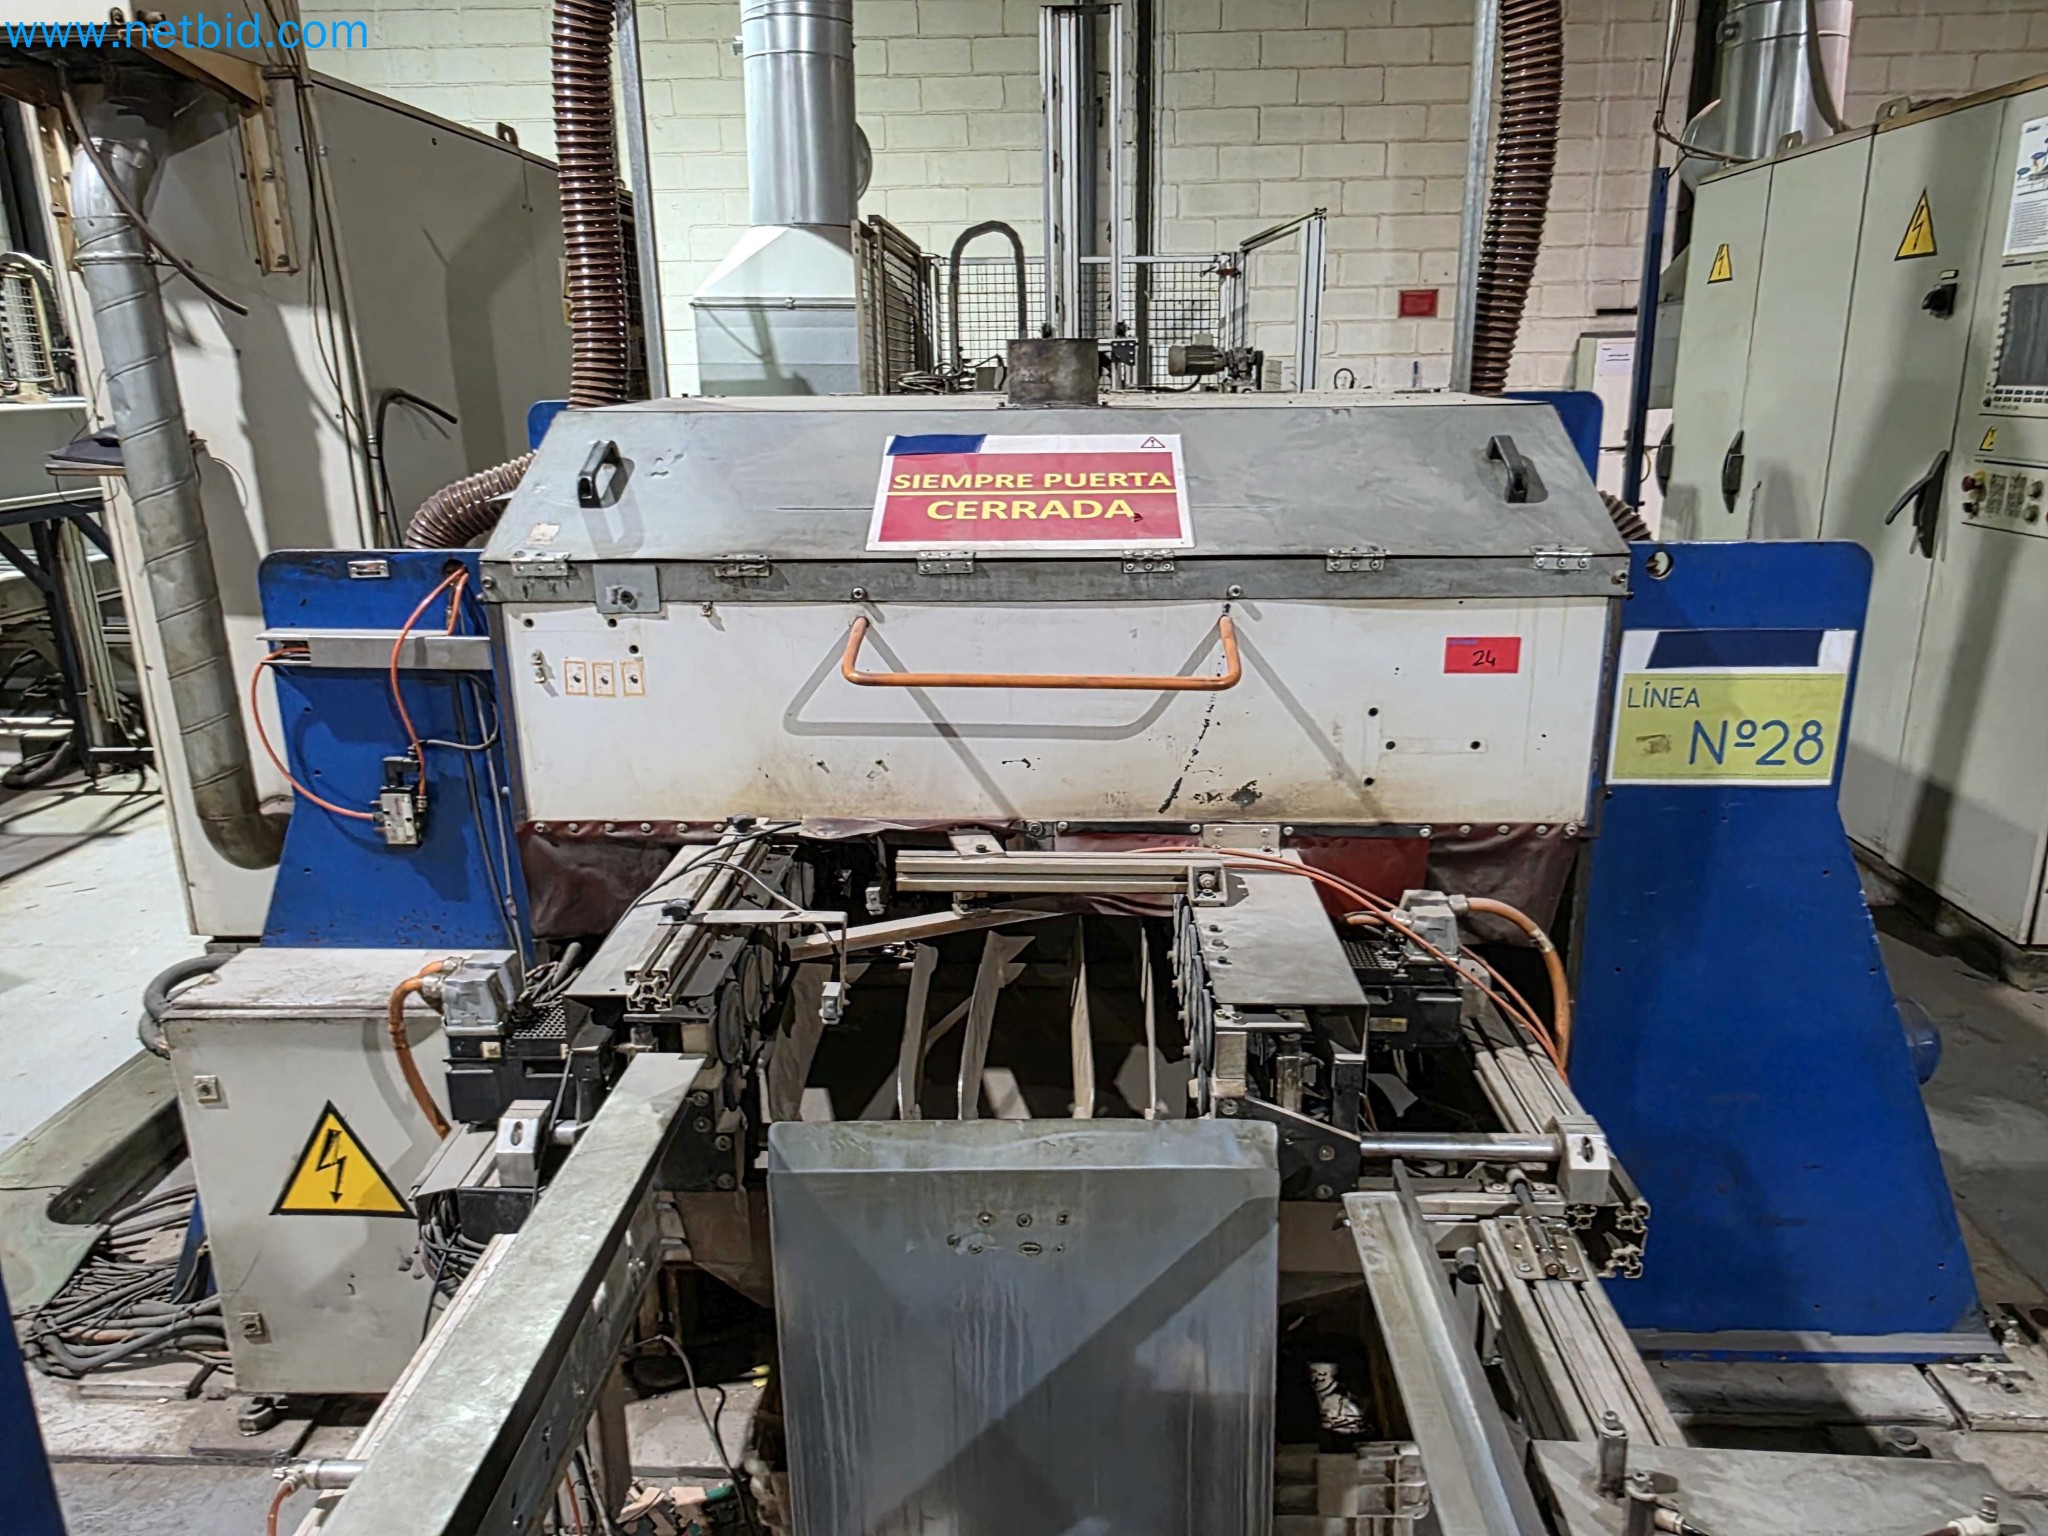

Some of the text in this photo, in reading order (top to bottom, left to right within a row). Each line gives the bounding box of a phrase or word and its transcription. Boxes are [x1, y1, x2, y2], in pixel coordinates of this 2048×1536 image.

[893, 472, 1172, 489] SIEMPRE PUERTA
[927, 499, 1135, 520] CERRADA
[1472, 649, 1496, 667] 24
[1627, 681, 1700, 708] LÍNEA
